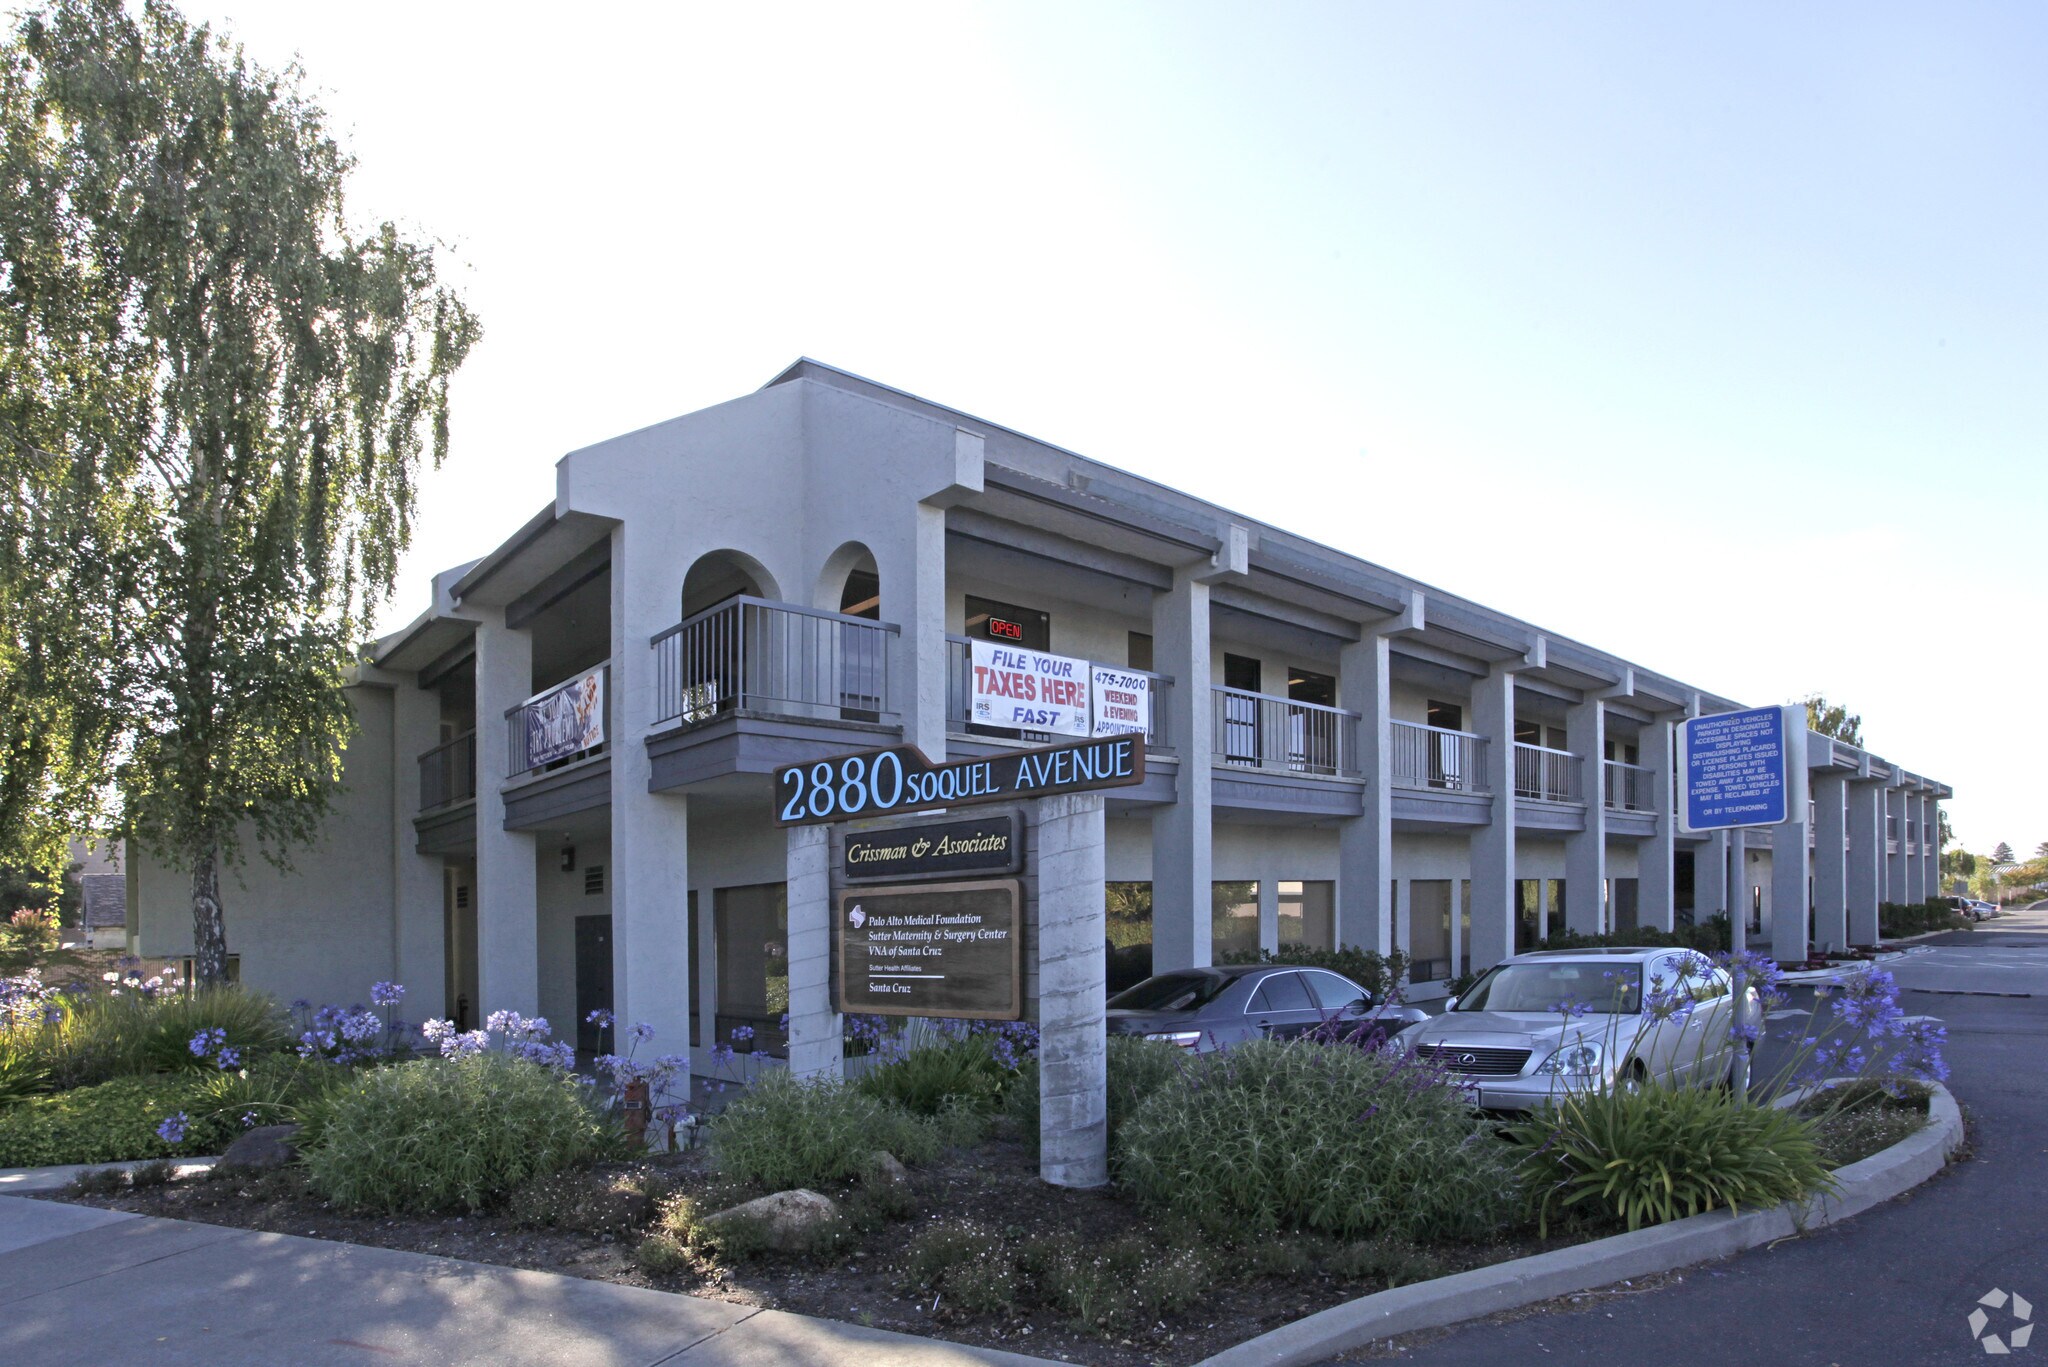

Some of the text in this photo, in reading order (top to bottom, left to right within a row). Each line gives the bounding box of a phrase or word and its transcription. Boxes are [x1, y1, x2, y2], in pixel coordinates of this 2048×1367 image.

[991, 621, 1021, 638] OPEN
[992, 650, 1072, 678] FILE YOUR
[974, 666, 1085, 708] TAXES HERE
[1095, 672, 1146, 690] 475-7000
[1104, 690, 1138, 706] WEEKEND
[976, 702, 990, 711] IRS
[1012, 707, 1060, 726] FAST
[1104, 707, 1138, 722] & EVENING
[1694, 715, 1773, 730] UNAUTHORIZED VEHICLES
[583, 725, 599, 747] NOTICE
[1697, 729, 1720, 737] PARKED
[1731, 723, 1769, 732] DESIGNATED
[1695, 735, 1731, 745] ACCESSIBLE
[1734, 731, 1758, 739] SPACES
[1716, 740, 1751, 749] DISPLAYING
[1693, 744, 1776, 759] DISTINGUISHING PLACARDS
[1702, 758, 1727, 766] LICENSE
[1755, 751, 1778, 759] ISSUED
[1718, 763, 1747, 771] PERSONS
[781, 741, 1132, 821] 2880 SOQUEL AVENUE
[1703, 771, 1740, 779] DISABILITIES
[1746, 774, 1775, 782] OWNER'S
[1749, 781, 1780, 789] VEHICLES
[1725, 790, 1760, 798] RECLAIMED
[1725, 804, 1768, 813] TELEPHONING
[848, 832, 1007, 863] Crissman & Associates
[869, 913, 981, 926] Palo Alto Medical Foundation
[869, 929, 1007, 943] Sutter Maternity & Surgery Center
[869, 946, 942, 958] VNA of Santa Cruz
[869, 983, 911, 993] Santa Cruz
